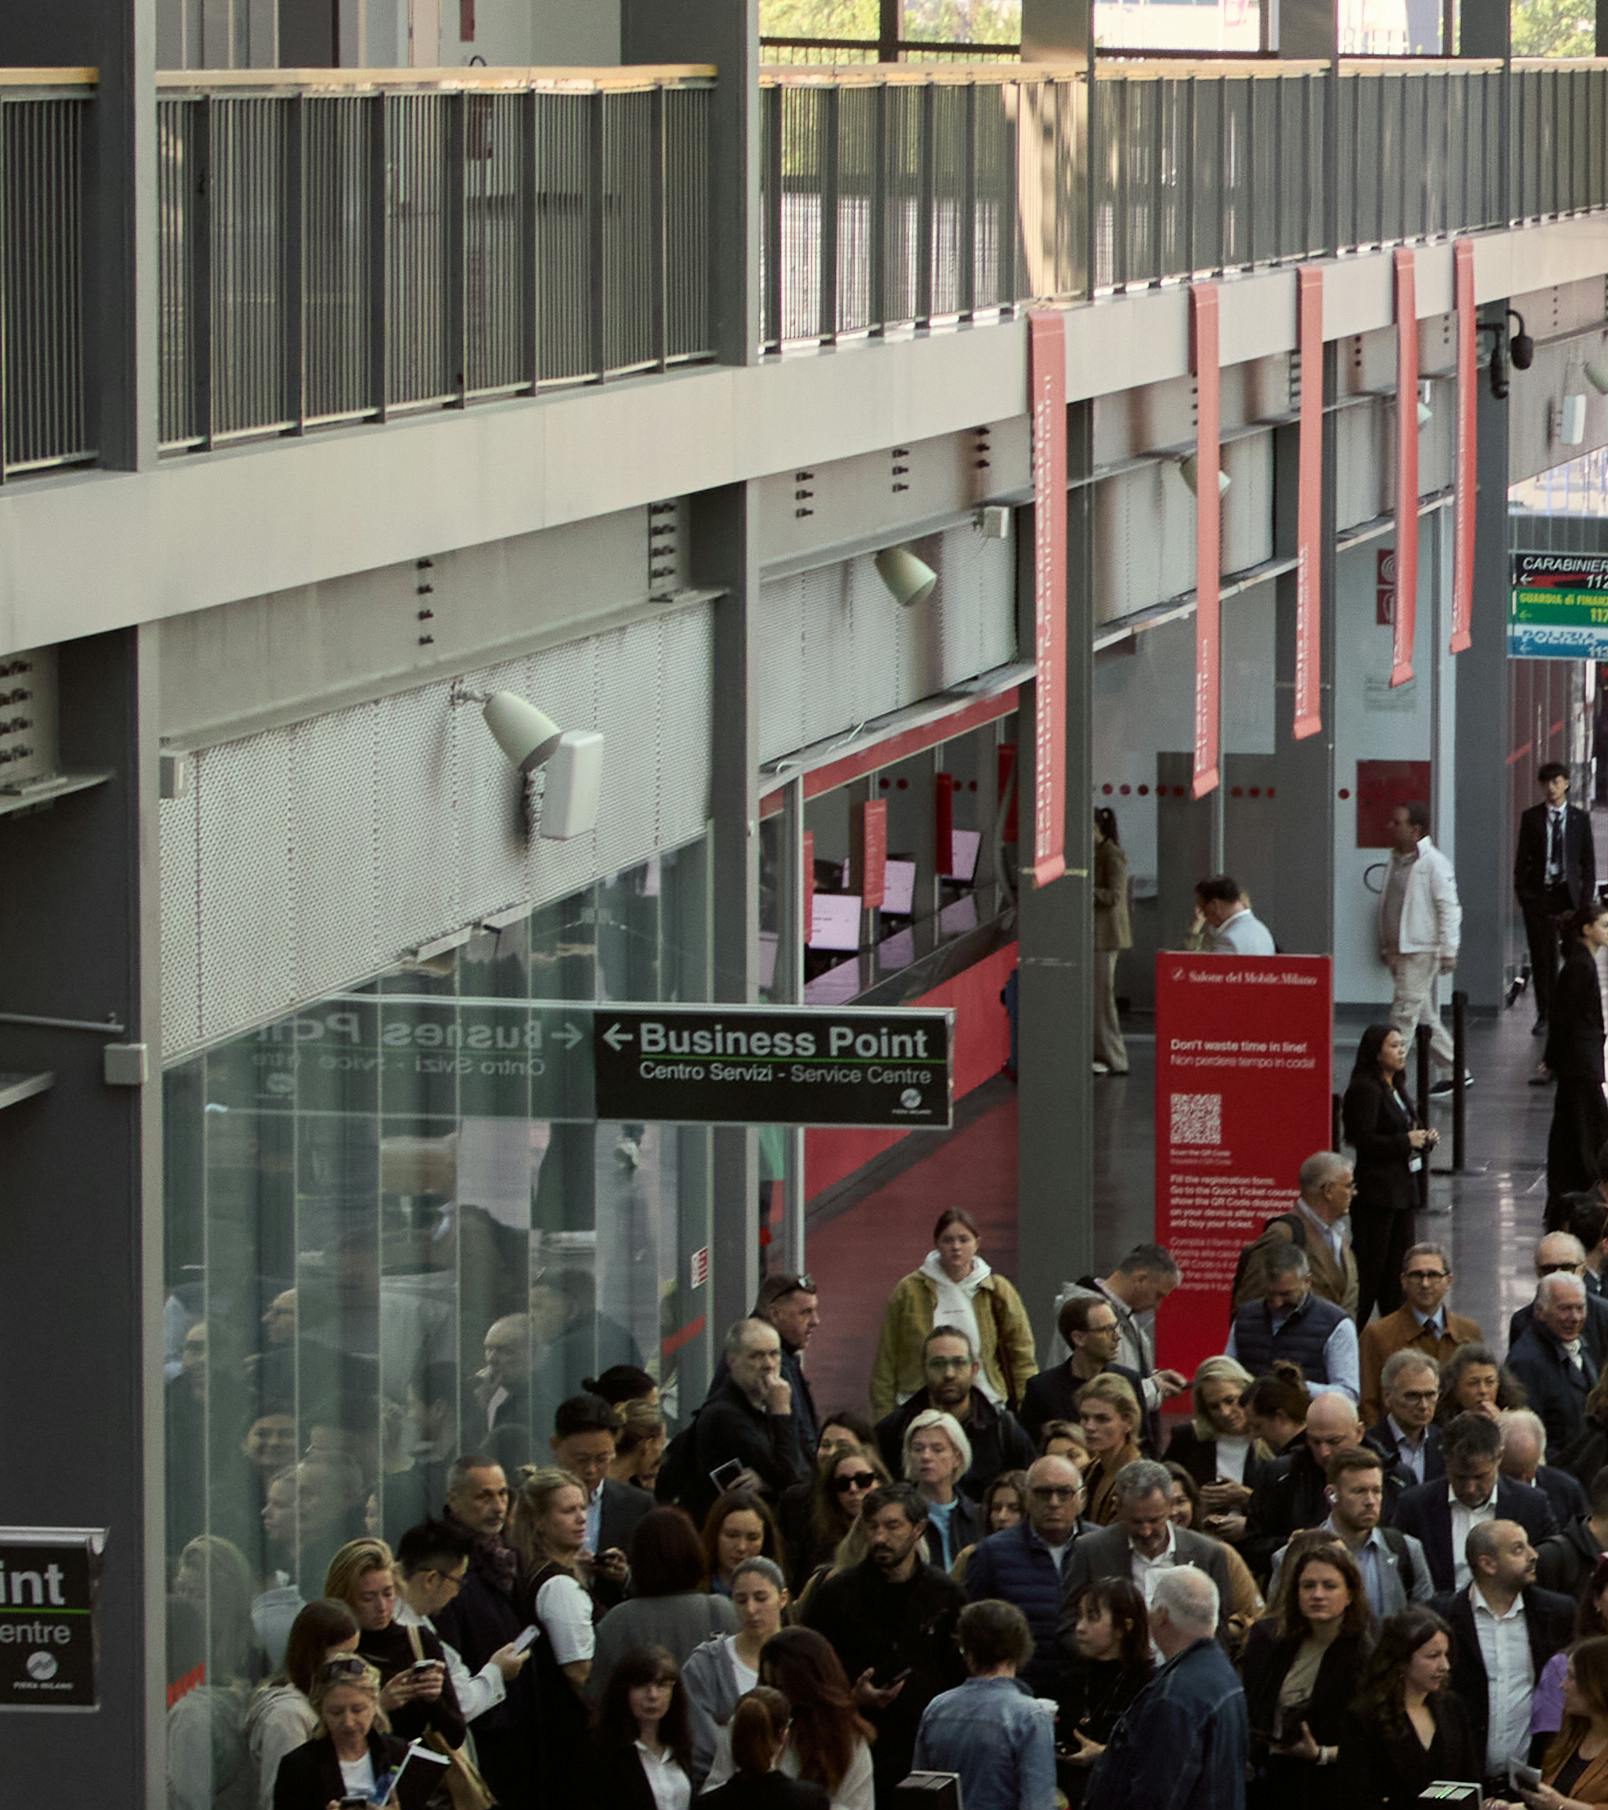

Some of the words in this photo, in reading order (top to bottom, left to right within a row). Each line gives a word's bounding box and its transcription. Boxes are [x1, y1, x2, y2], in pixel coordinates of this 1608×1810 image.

[1520, 630, 1598, 645] POLIZIA
[640, 1023, 817, 1056] Business
[829, 1026, 928, 1059] Point
[1170, 1039, 1202, 1051] Don't
[1204, 1041, 1239, 1051] waste
[1241, 1041, 1267, 1052] time
[1269, 1042, 1281, 1052] in
[1170, 1054, 1194, 1065] Non
[1238, 1056, 1273, 1068] tempo
[1275, 1056, 1285, 1067] in
[640, 1062, 705, 1080] Centro
[710, 1064, 773, 1082] Servizi
[791, 1065, 862, 1083] Service
[868, 1066, 932, 1084] Centre
[1185, 1175, 1199, 1184] the
[1196, 1187, 1210, 1195] the
[1195, 1198, 1209, 1206] the
